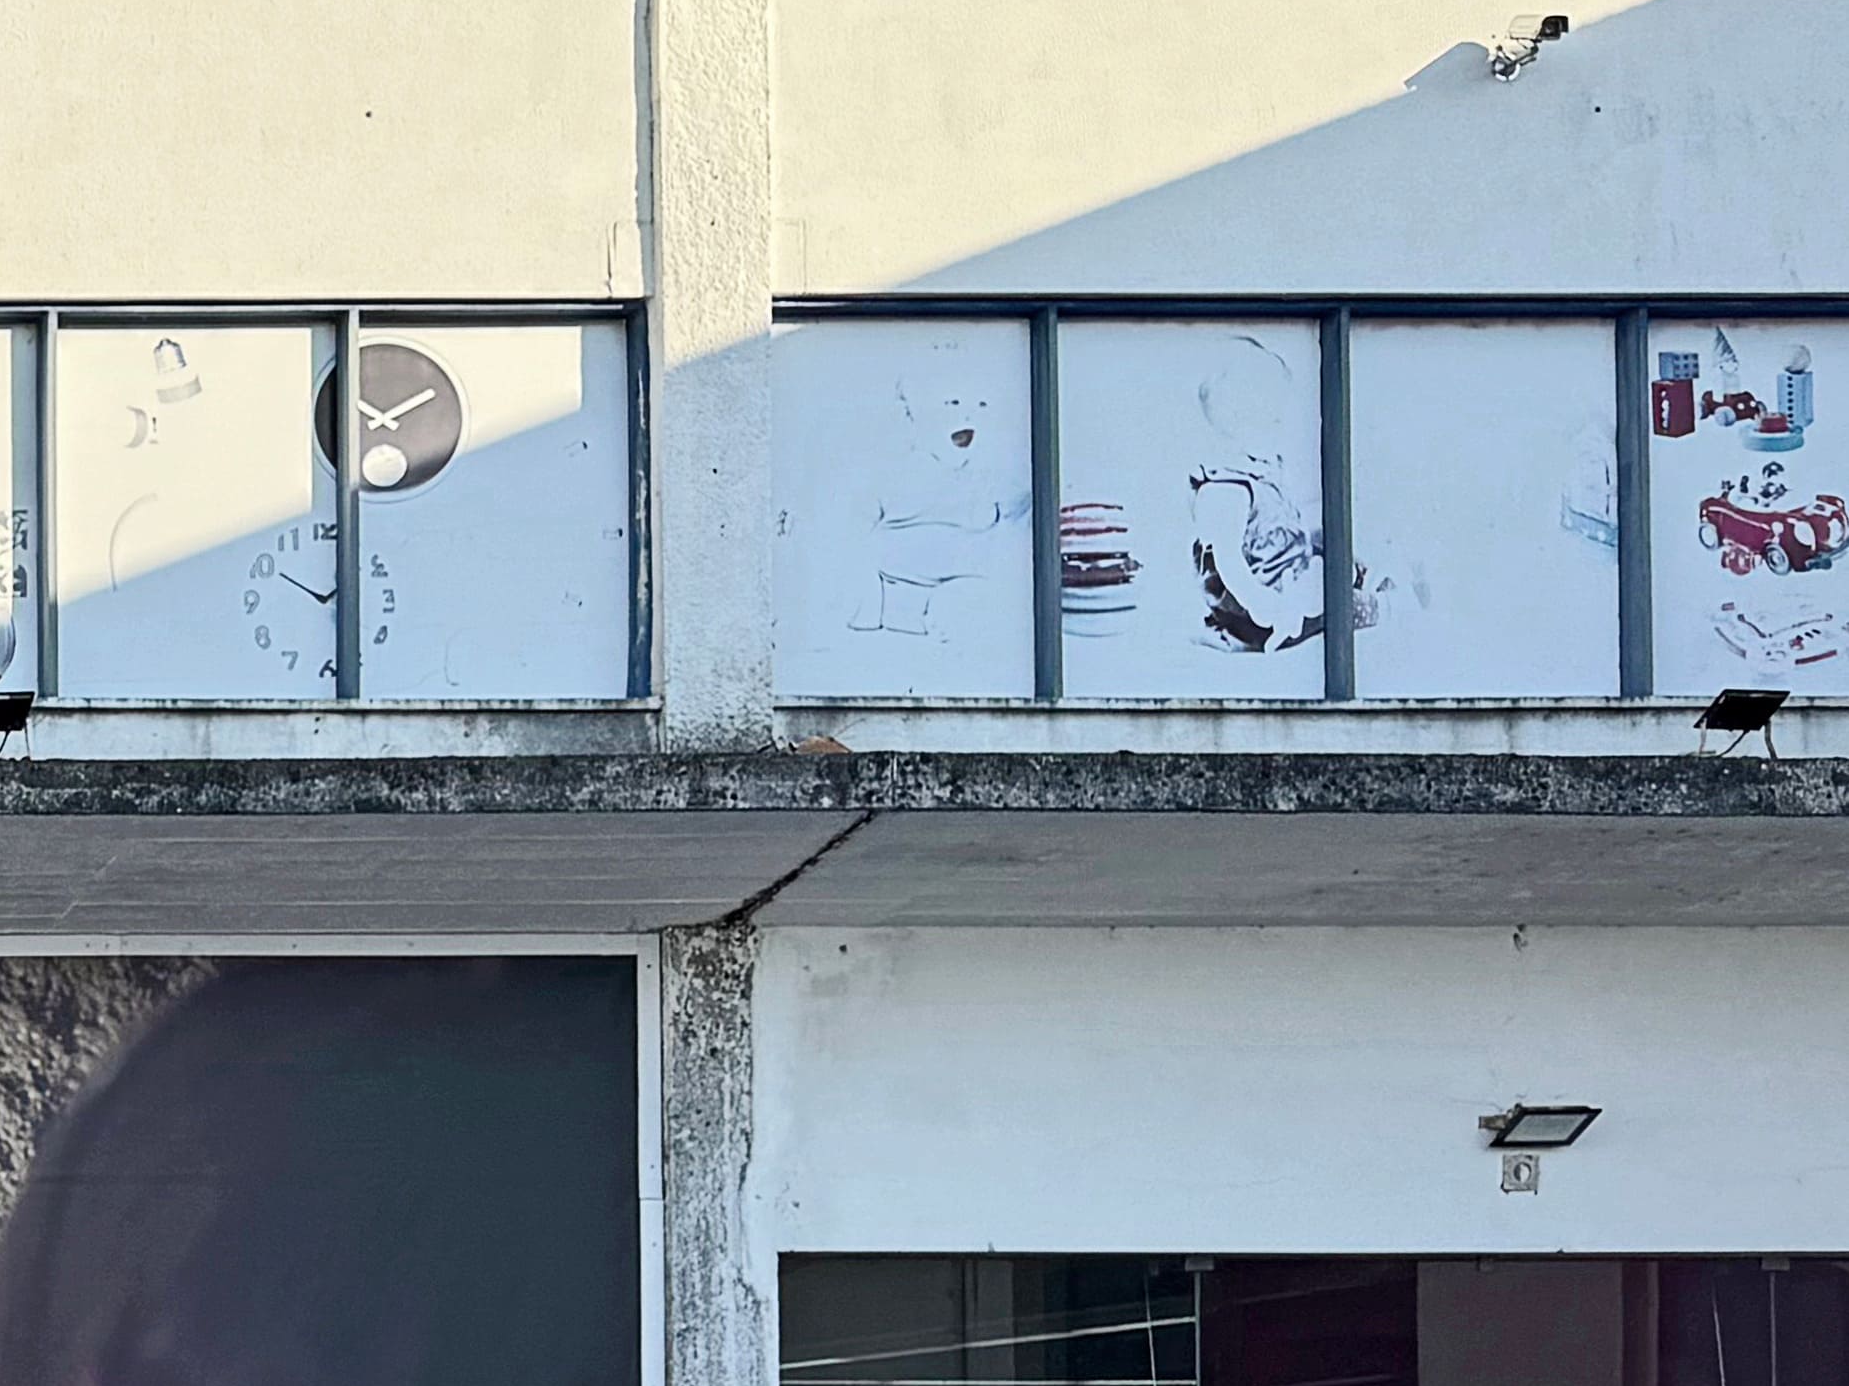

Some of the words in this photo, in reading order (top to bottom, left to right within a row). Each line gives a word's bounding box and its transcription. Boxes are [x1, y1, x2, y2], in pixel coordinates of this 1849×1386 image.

[243, 589, 260, 614] 9
[254, 625, 271, 650] 8
[281, 650, 299, 671] 7
